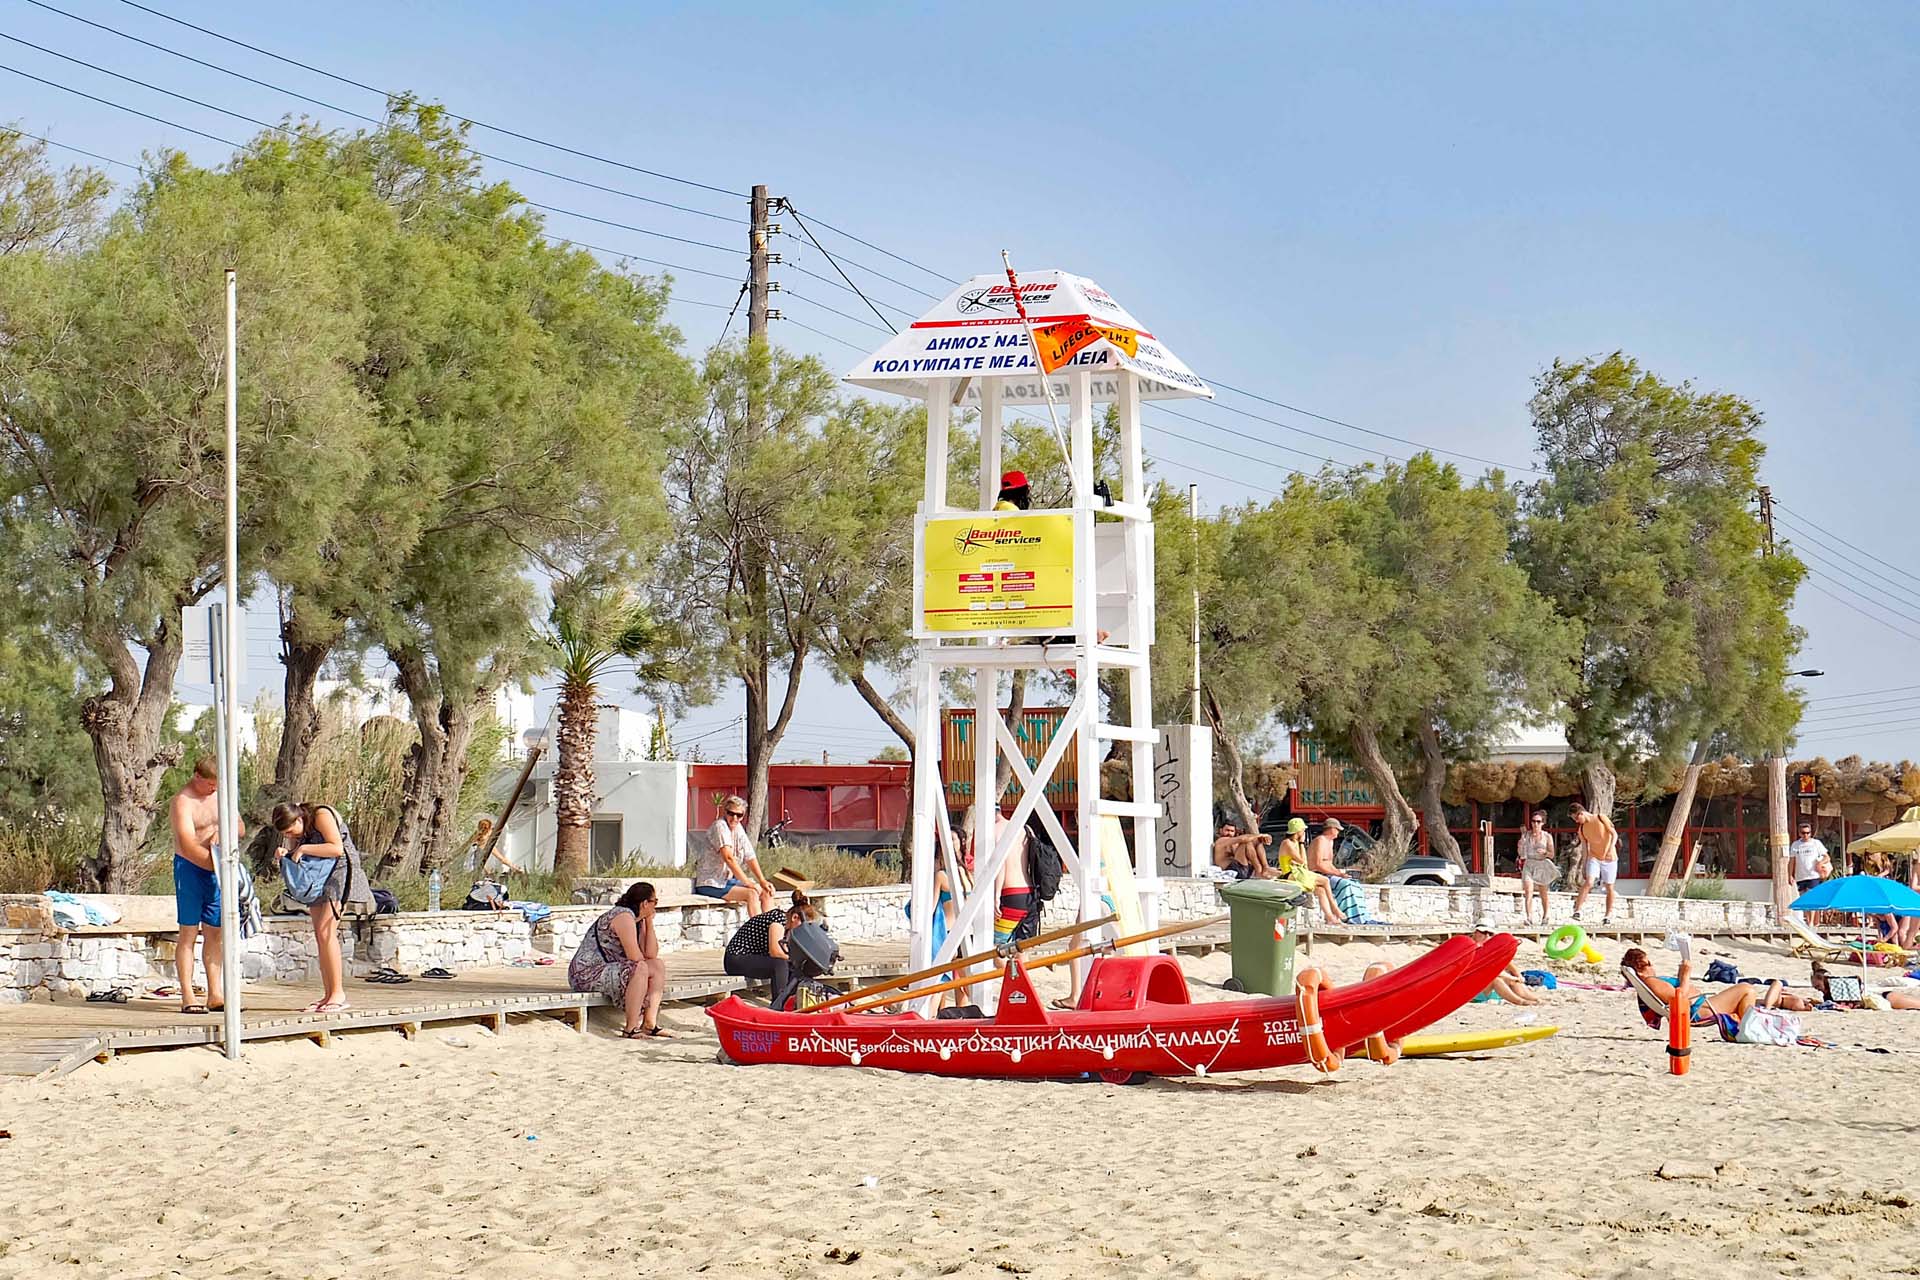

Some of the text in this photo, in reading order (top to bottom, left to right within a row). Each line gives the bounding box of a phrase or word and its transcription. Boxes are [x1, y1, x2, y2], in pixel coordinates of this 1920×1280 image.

[987, 283, 1058, 295] Baline
[987, 294, 1051, 303] serices
[925, 335, 990, 351] ΔΗΜΟΣ
[872, 356, 985, 373] ΚΟΛΥΜΠΑΤΕ
[989, 354, 1015, 369] ΜΕ
[971, 529, 1022, 541] Bayline
[995, 536, 1041, 545] services
[733, 1030, 780, 1043] RESCUE
[788, 1038, 857, 1053] BAYLINE
[860, 1044, 910, 1053] services
[1057, 1032, 1150, 1050] ΑΚΑΔΗΜΙΑ
[1156, 1027, 1240, 1048] ΕΛΛΑΔΟΣ
[741, 1040, 772, 1053] BOAT
